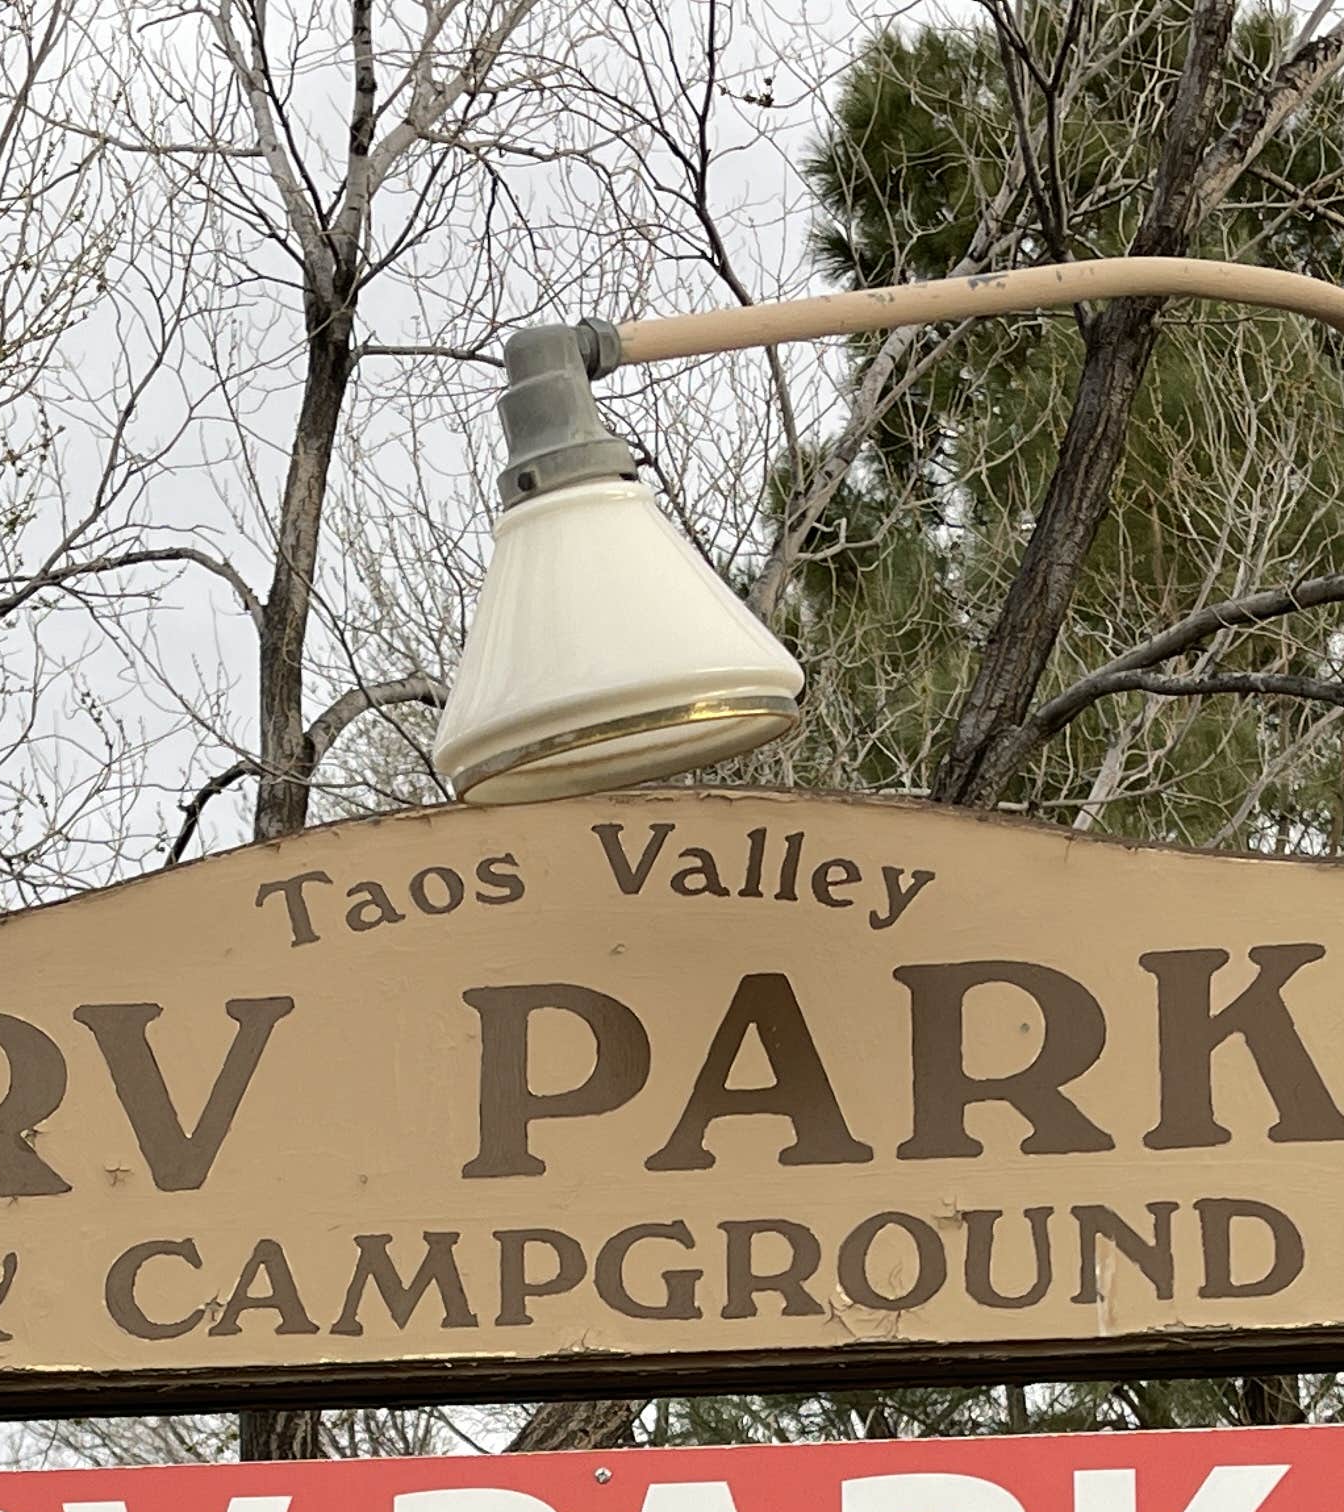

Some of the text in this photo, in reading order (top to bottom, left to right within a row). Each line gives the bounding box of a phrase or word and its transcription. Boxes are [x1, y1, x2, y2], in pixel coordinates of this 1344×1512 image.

[257, 822, 936, 949] Taos Valley
[104, 1197, 1306, 1338] CAMPGROUND
